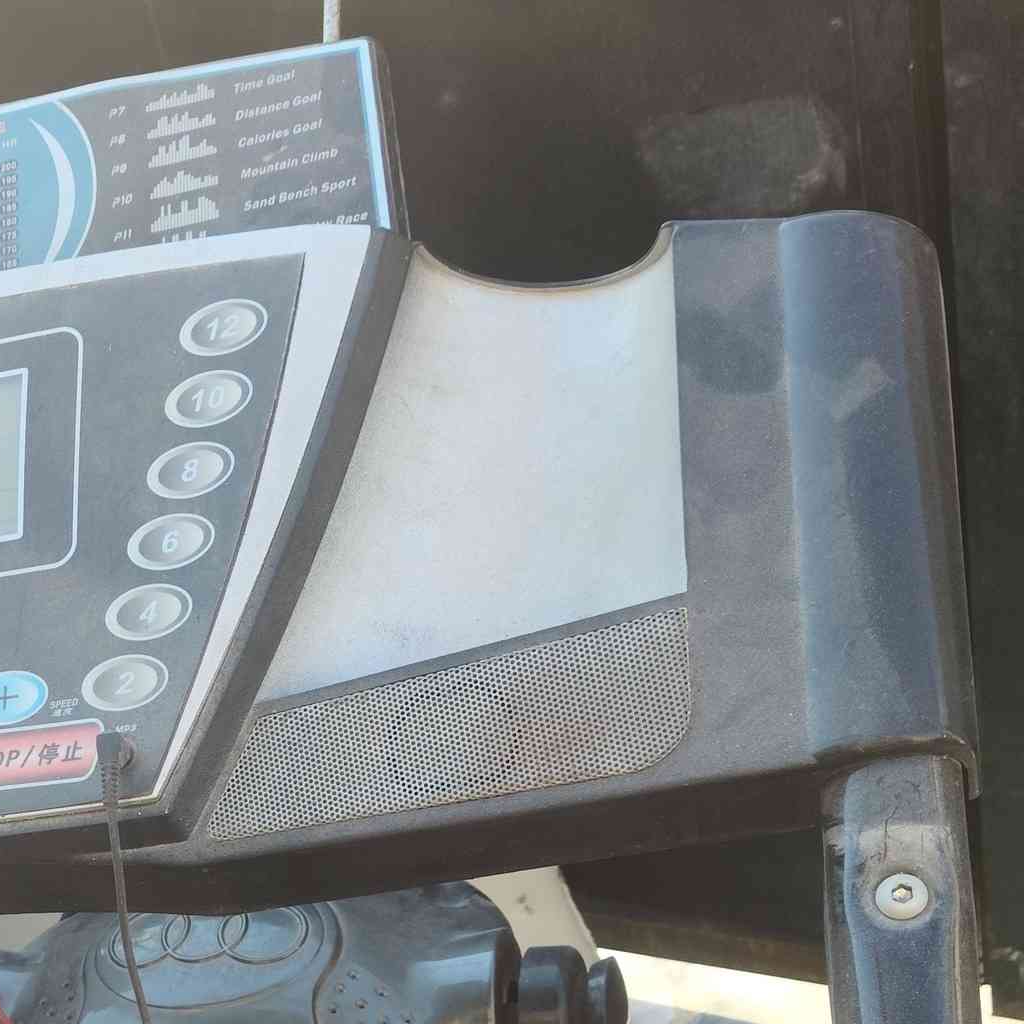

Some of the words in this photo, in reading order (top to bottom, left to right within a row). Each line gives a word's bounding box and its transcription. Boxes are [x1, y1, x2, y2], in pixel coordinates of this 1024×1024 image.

[233, 80, 263, 95] Time
[266, 69, 296, 86] Goal
[109, 104, 126, 119] P7
[235, 98, 291, 121] Distance
[293, 90, 323, 106] Goal
[237, 127, 290, 149] Calories
[292, 118, 323, 135] Goal
[239, 156, 299, 180] Mountain
[301, 147, 339, 166] Climb
[112, 193, 133, 208] P10
[243, 194, 276, 212] Sand
[279, 184, 318, 205] Bench
[321, 176, 358, 196] Sport
[335, 211, 369, 225] Race
[206, 314, 240, 341] 12
[191, 386, 225, 413] 10
[181, 458, 199, 482] 8
[161, 530, 178, 553] 6
[138, 600, 158, 623] 4
[114, 671, 135, 695] 2
[49, 697, 79, 710] SPEED
